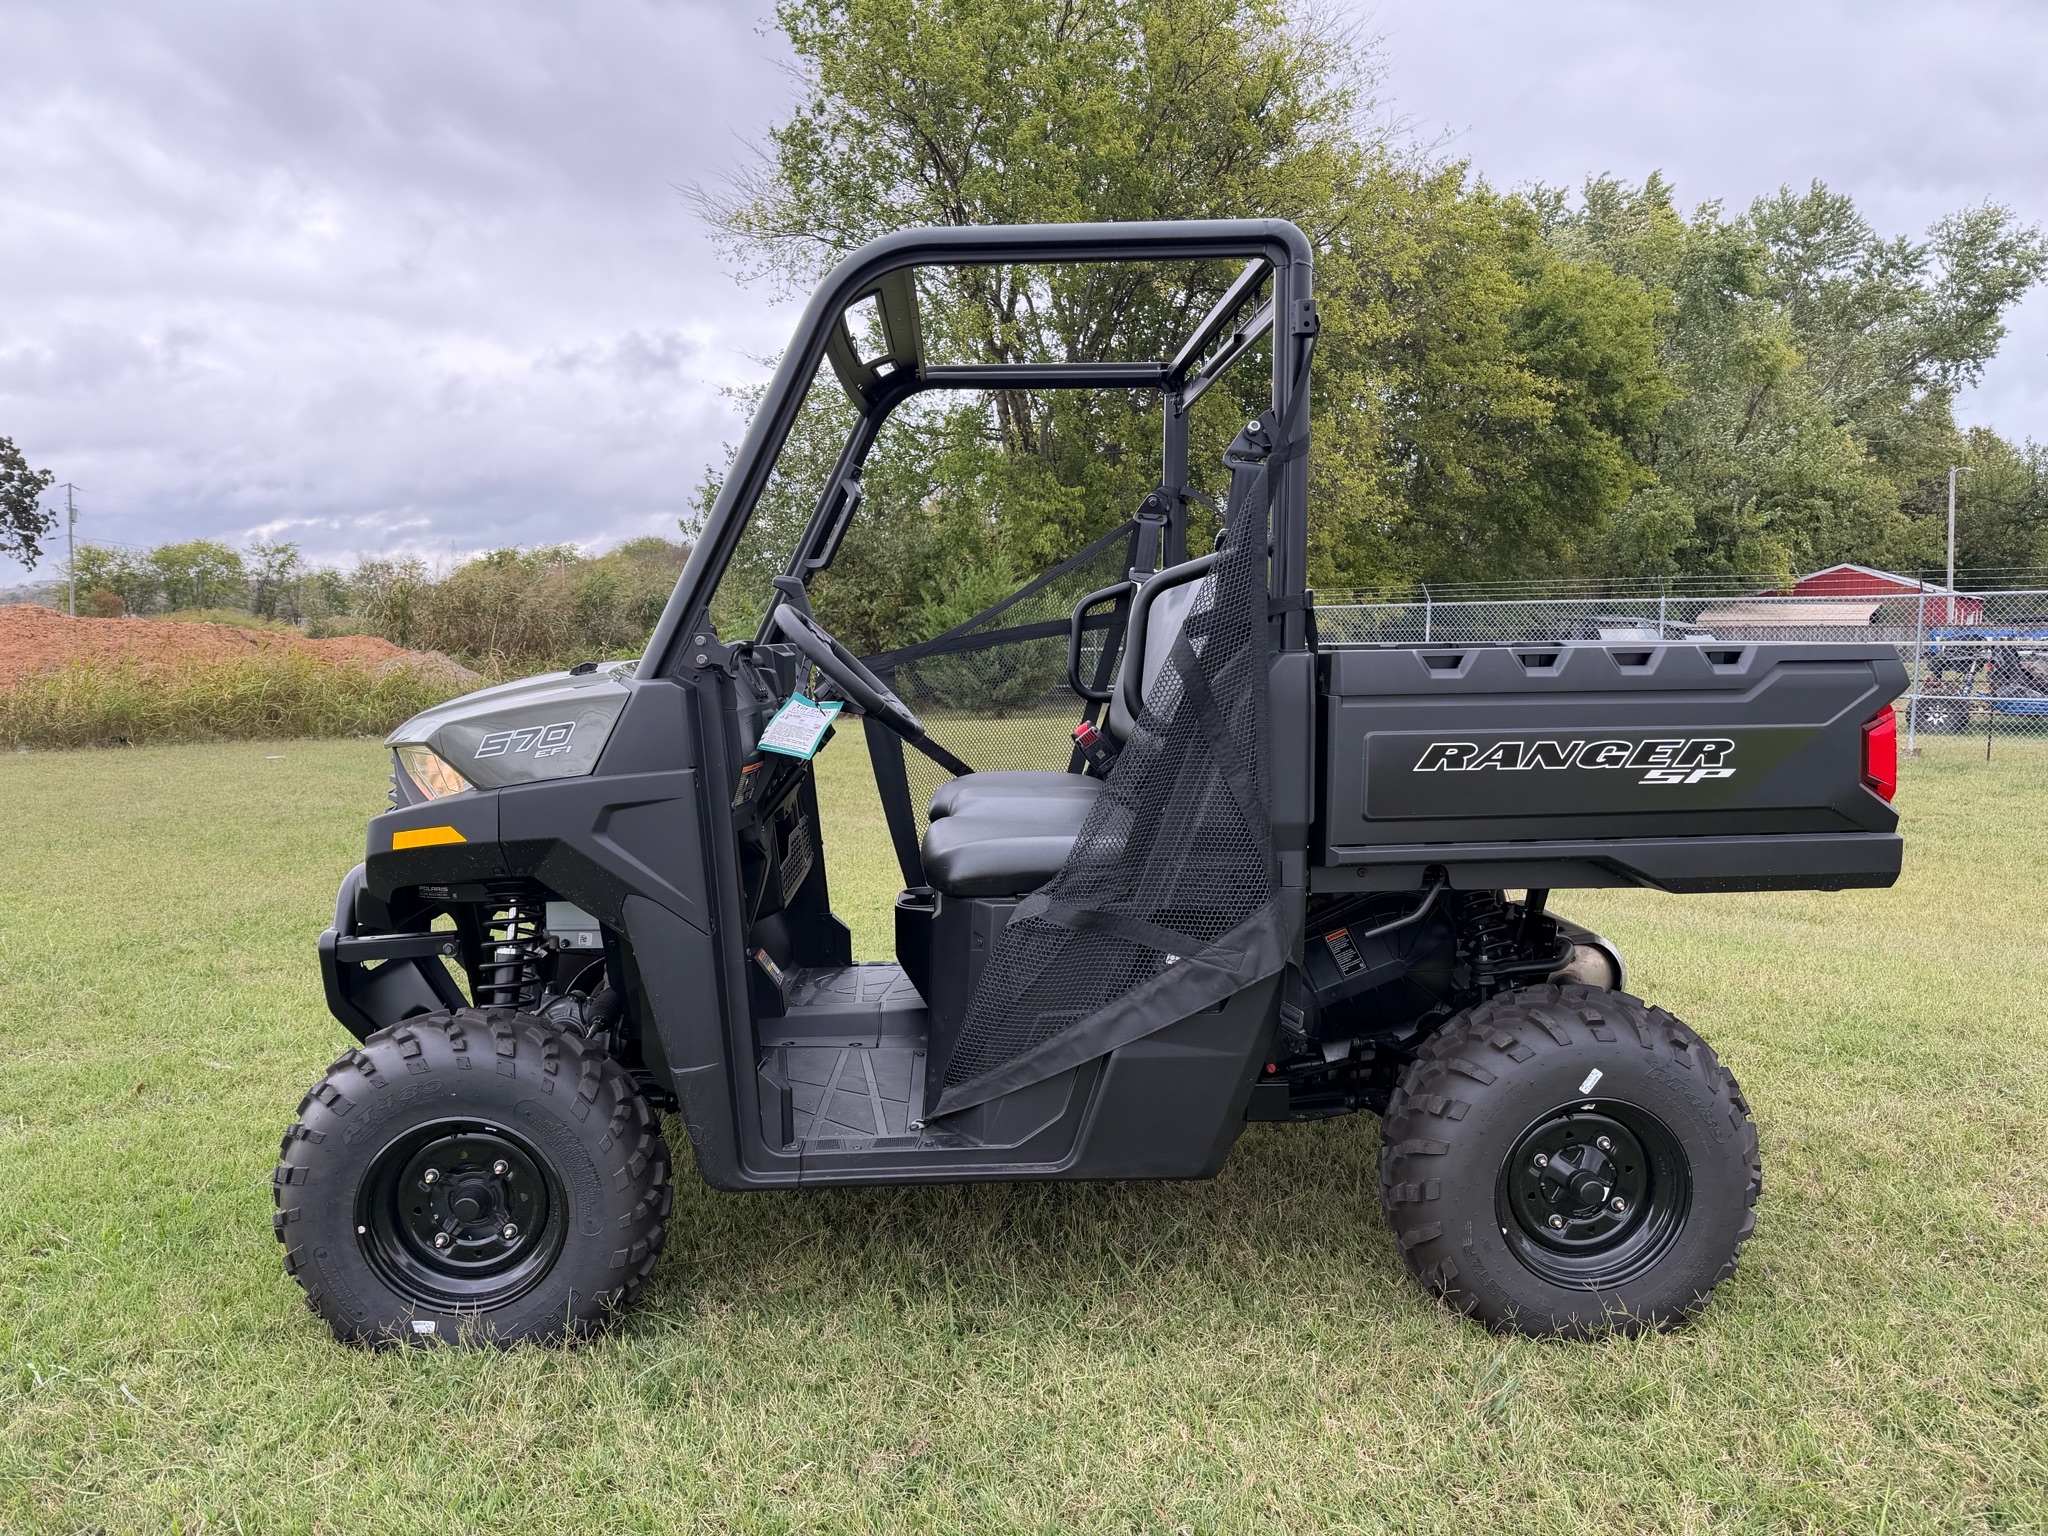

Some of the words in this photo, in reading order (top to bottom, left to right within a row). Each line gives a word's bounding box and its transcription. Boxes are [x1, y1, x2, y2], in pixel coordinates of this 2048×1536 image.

[474, 721, 576, 759] 570
[534, 745, 572, 759] EFI
[1413, 739, 1735, 771] RANGER
[1638, 768, 1736, 784] SP
